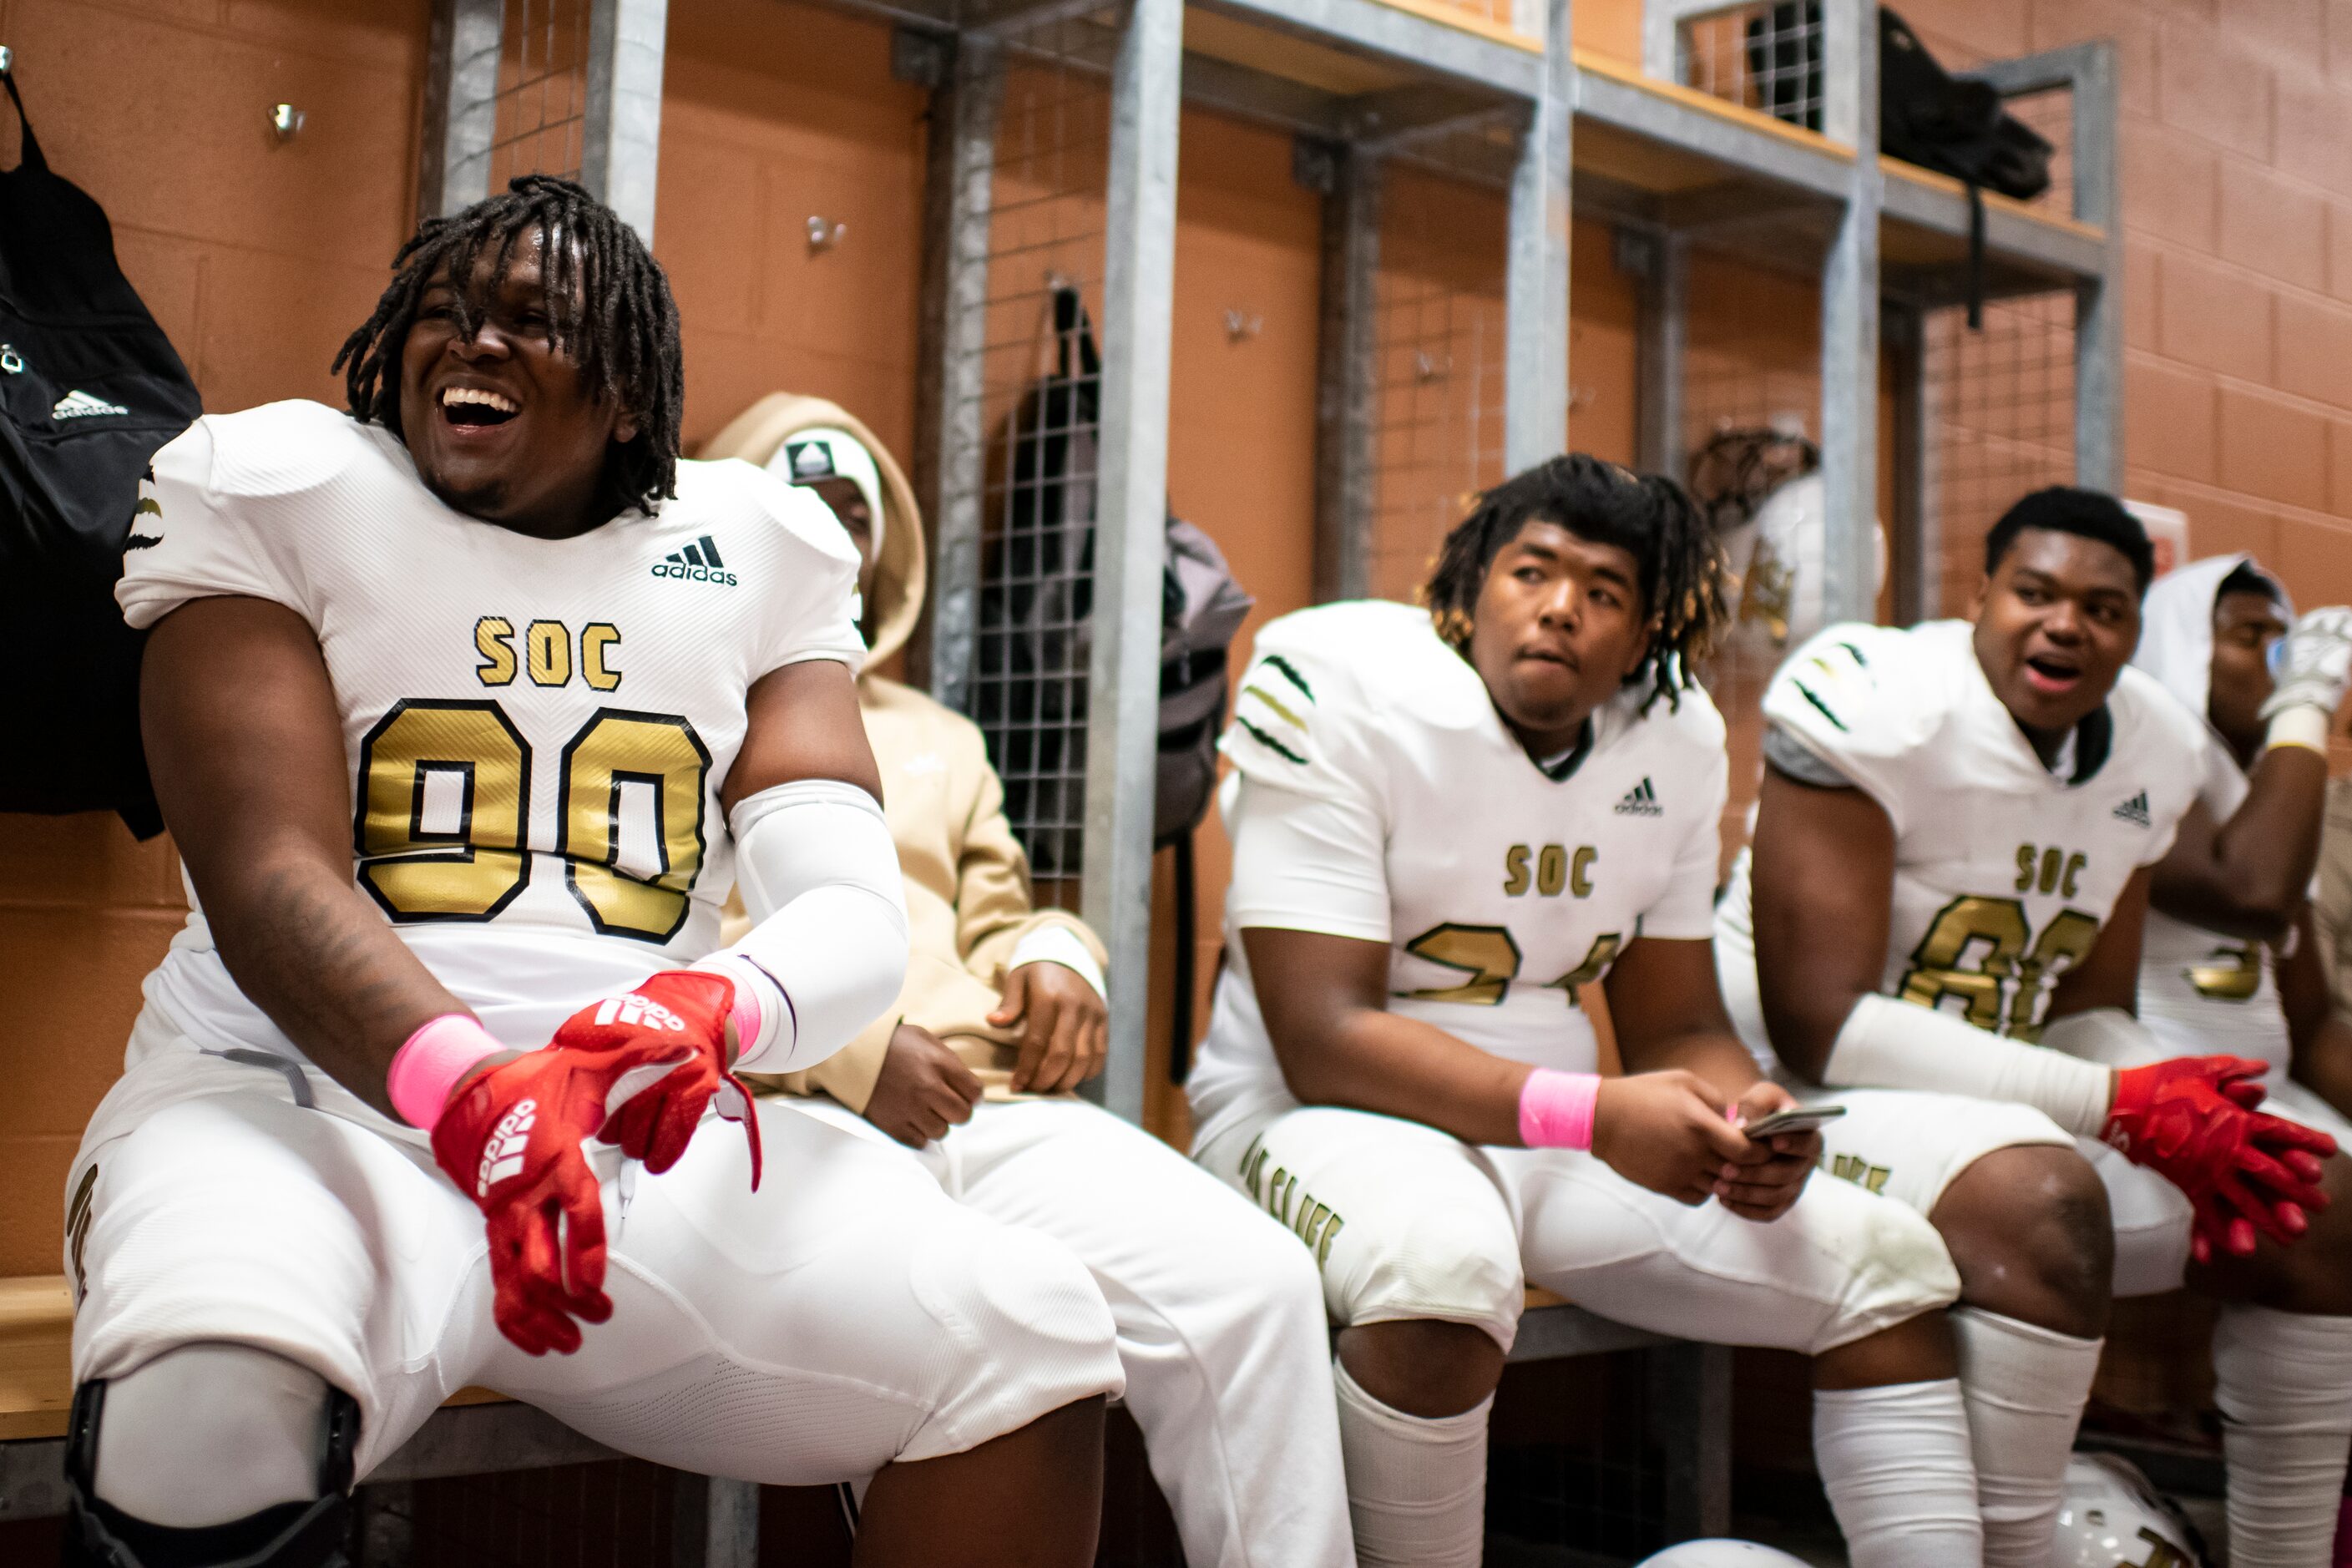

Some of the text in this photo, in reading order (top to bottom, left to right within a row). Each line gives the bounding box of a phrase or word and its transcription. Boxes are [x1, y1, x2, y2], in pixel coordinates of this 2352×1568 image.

[651, 563, 737, 586] adidas
[473, 616, 621, 692] SOC
[354, 698, 713, 946] 90
[1504, 844, 1598, 899] SOC
[2014, 843, 2087, 899] SOC
[477, 1099, 538, 1199] adidas
